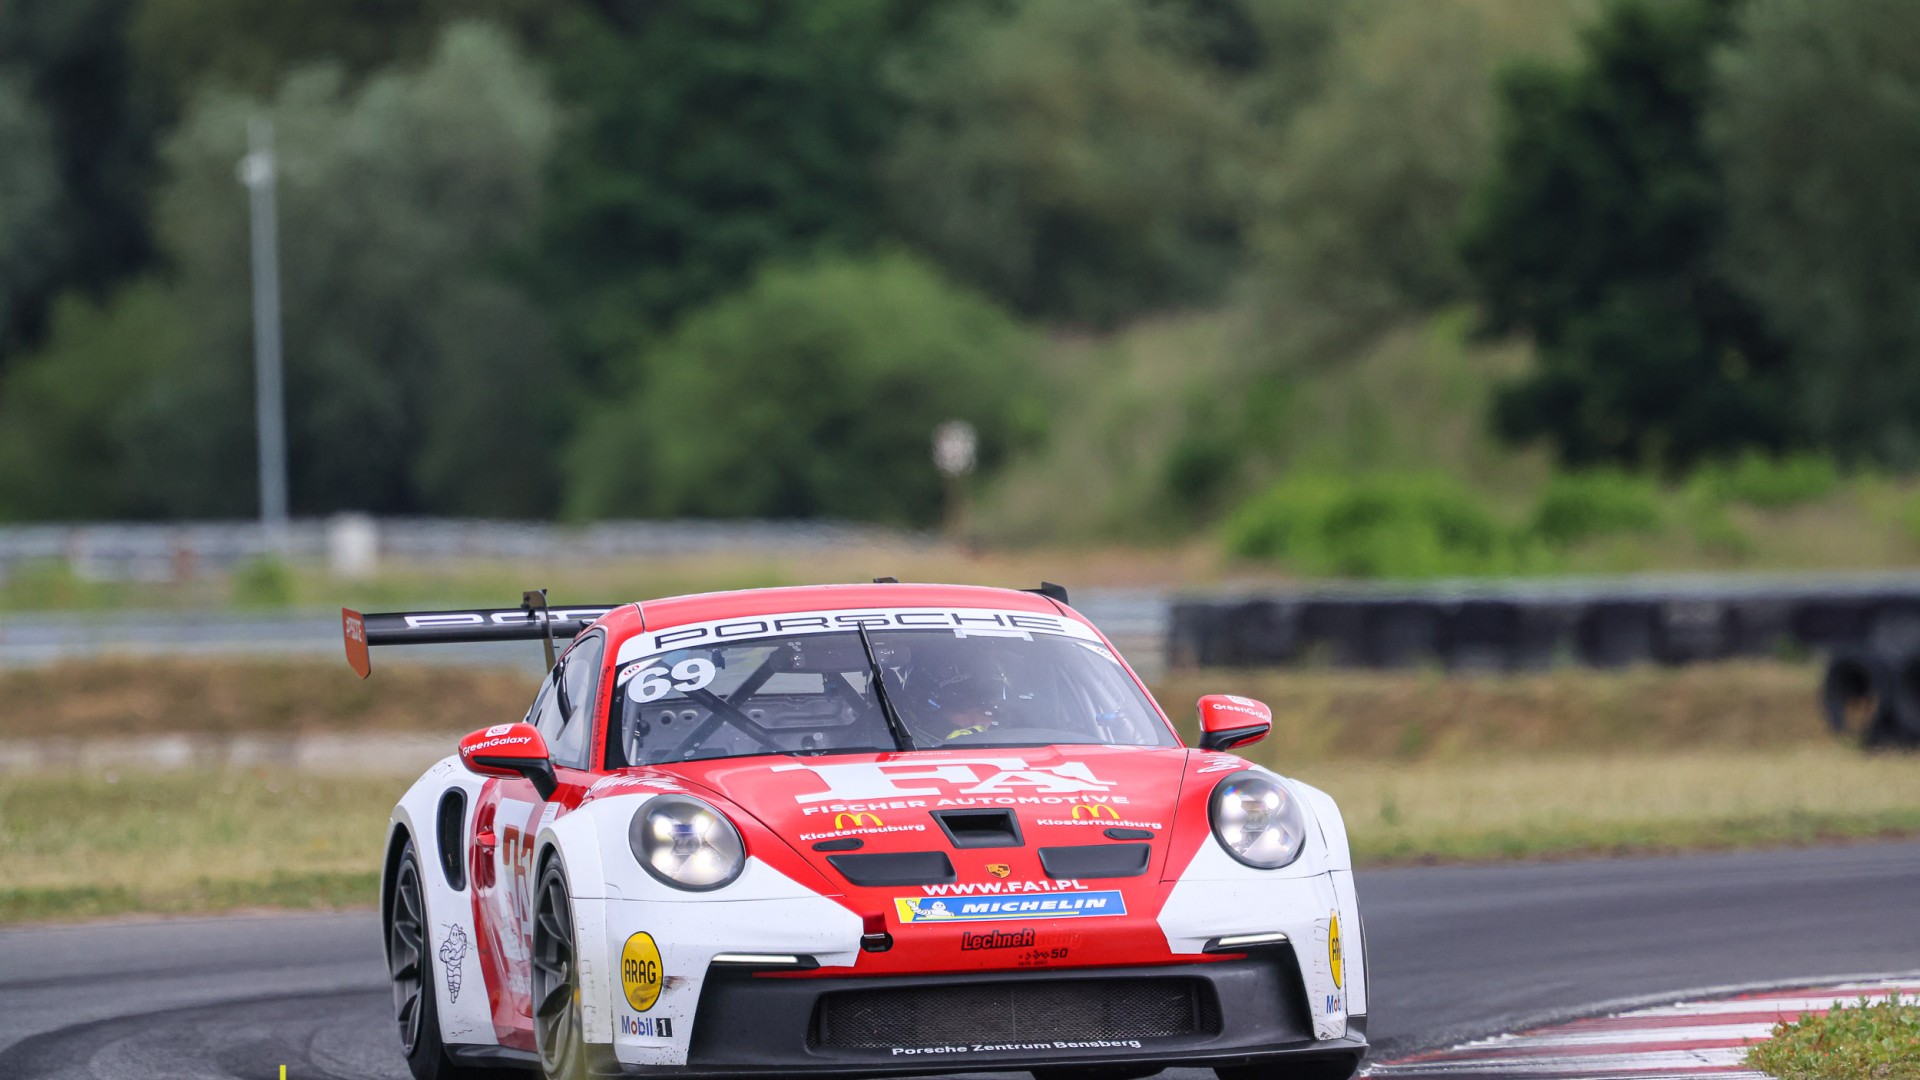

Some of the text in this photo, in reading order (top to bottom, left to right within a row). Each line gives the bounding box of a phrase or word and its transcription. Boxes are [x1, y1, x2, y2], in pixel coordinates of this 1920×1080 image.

[655, 613, 1065, 649] PORSCHE
[628, 658, 716, 704] 69
[462, 736, 532, 757] GreenGalaxy
[802, 795, 1130, 816] FISCHER AUTOMOTIVE
[800, 824, 926, 841] Klosterneuburg
[1037, 818, 1163, 830] Klosterneuburg
[922, 879, 1089, 896] WWW.FA1.PL
[961, 898, 1108, 914] MICHELIN
[624, 958, 657, 985] ARAG
[621, 1014, 654, 1038] Mobil
[892, 1039, 1142, 1056] Porsche Zentrum Bensberg
